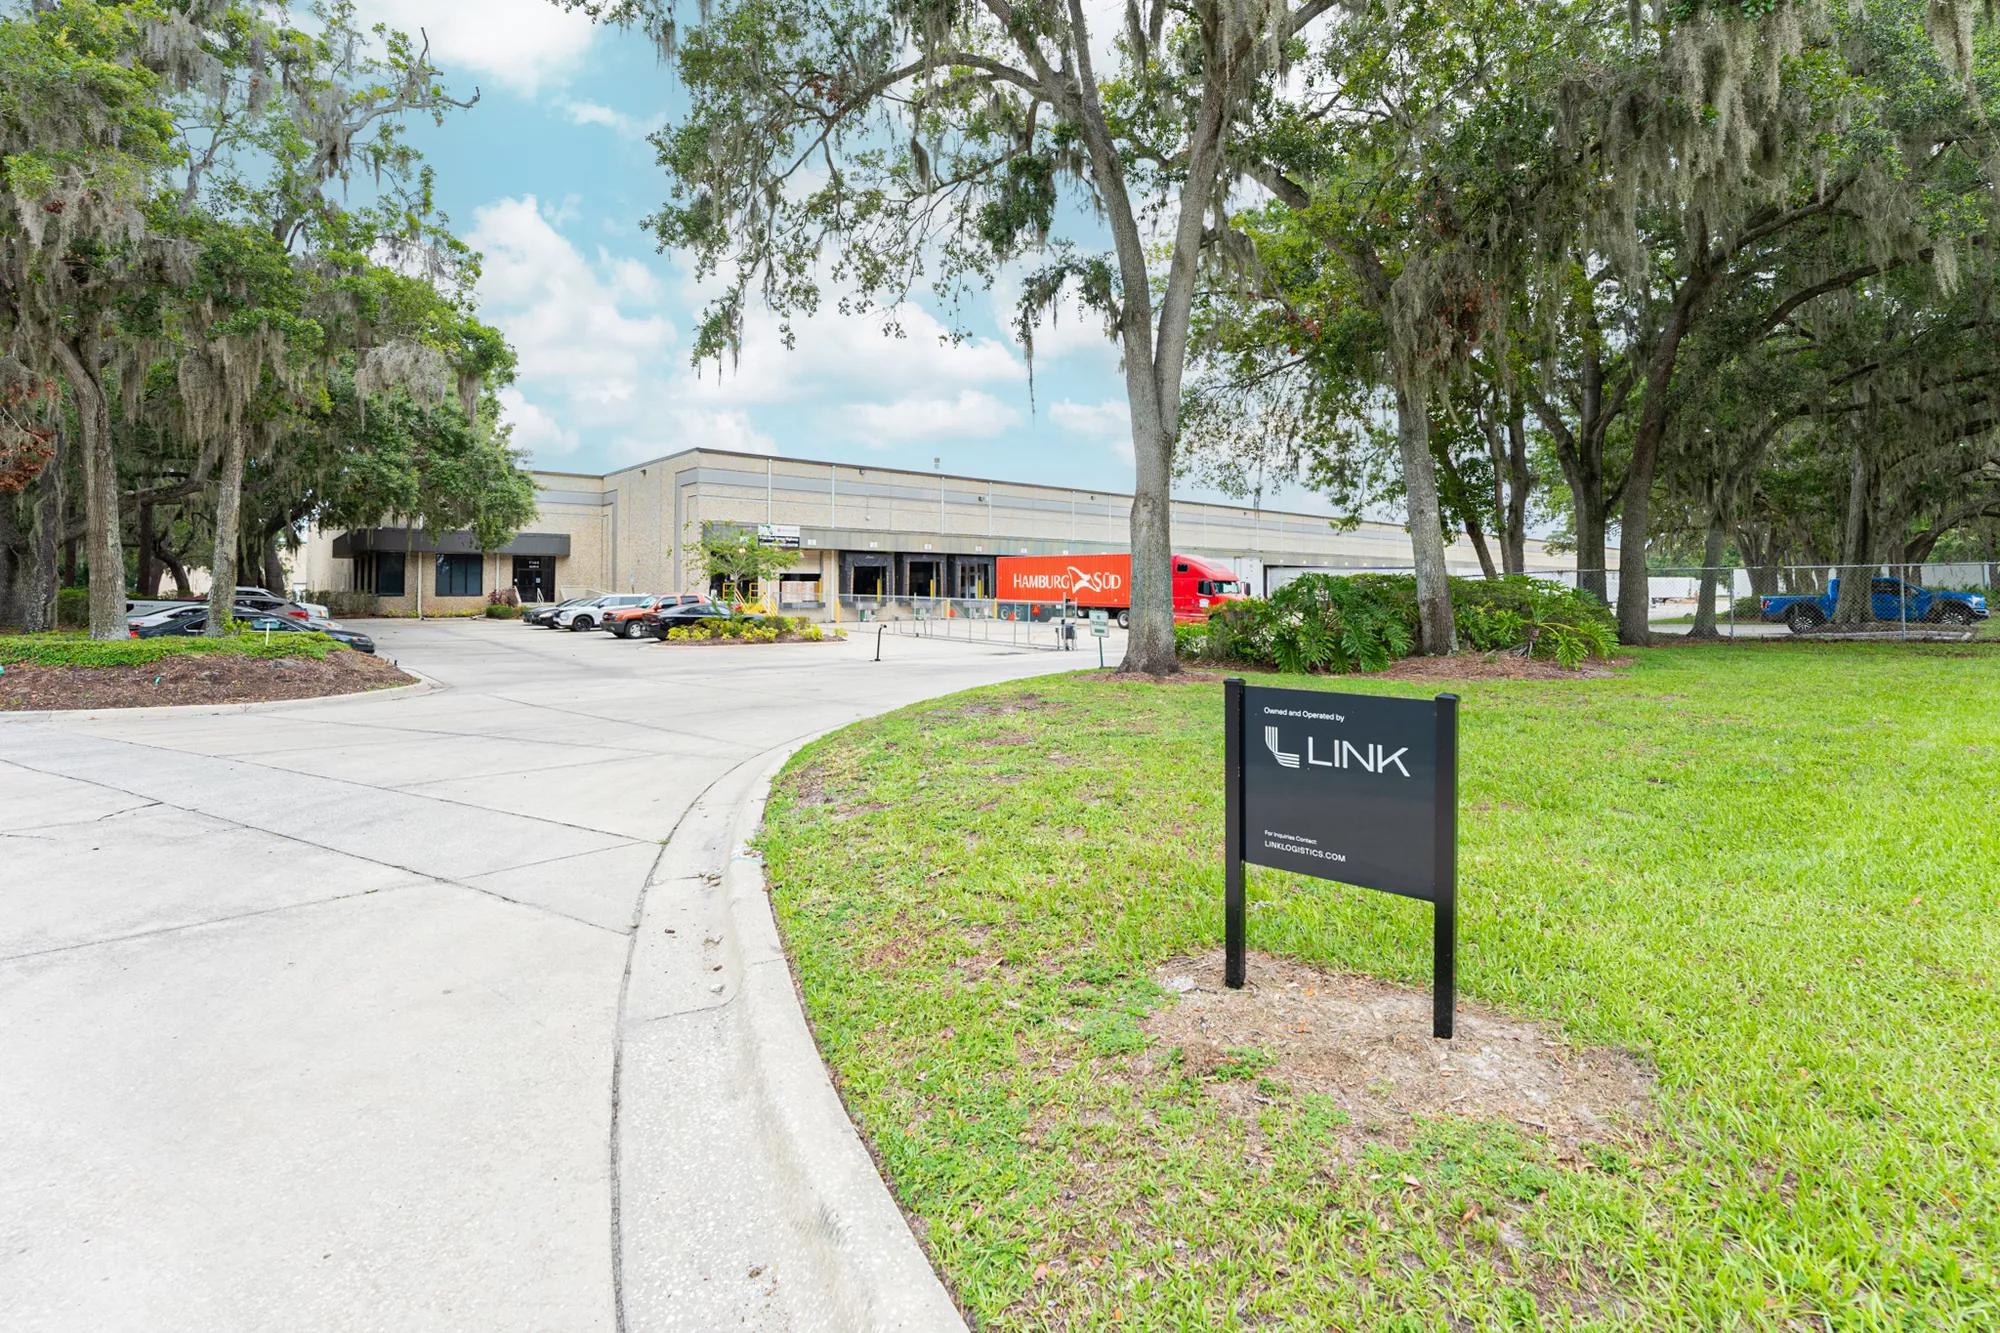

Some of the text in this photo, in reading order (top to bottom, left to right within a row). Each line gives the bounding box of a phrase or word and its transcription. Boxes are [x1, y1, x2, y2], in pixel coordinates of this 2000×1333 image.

[1013, 573, 1070, 590] HAMBURG
[1263, 706, 1288, 716] Owned
[1302, 710, 1335, 721] Operated
[1335, 713, 1345, 723] by
[1307, 736, 1411, 778] LINK
[1264, 829, 1274, 837] For
[1273, 831, 1295, 841] Inquiries
[1264, 840, 1346, 863] LINKLOGISTICS.COM
